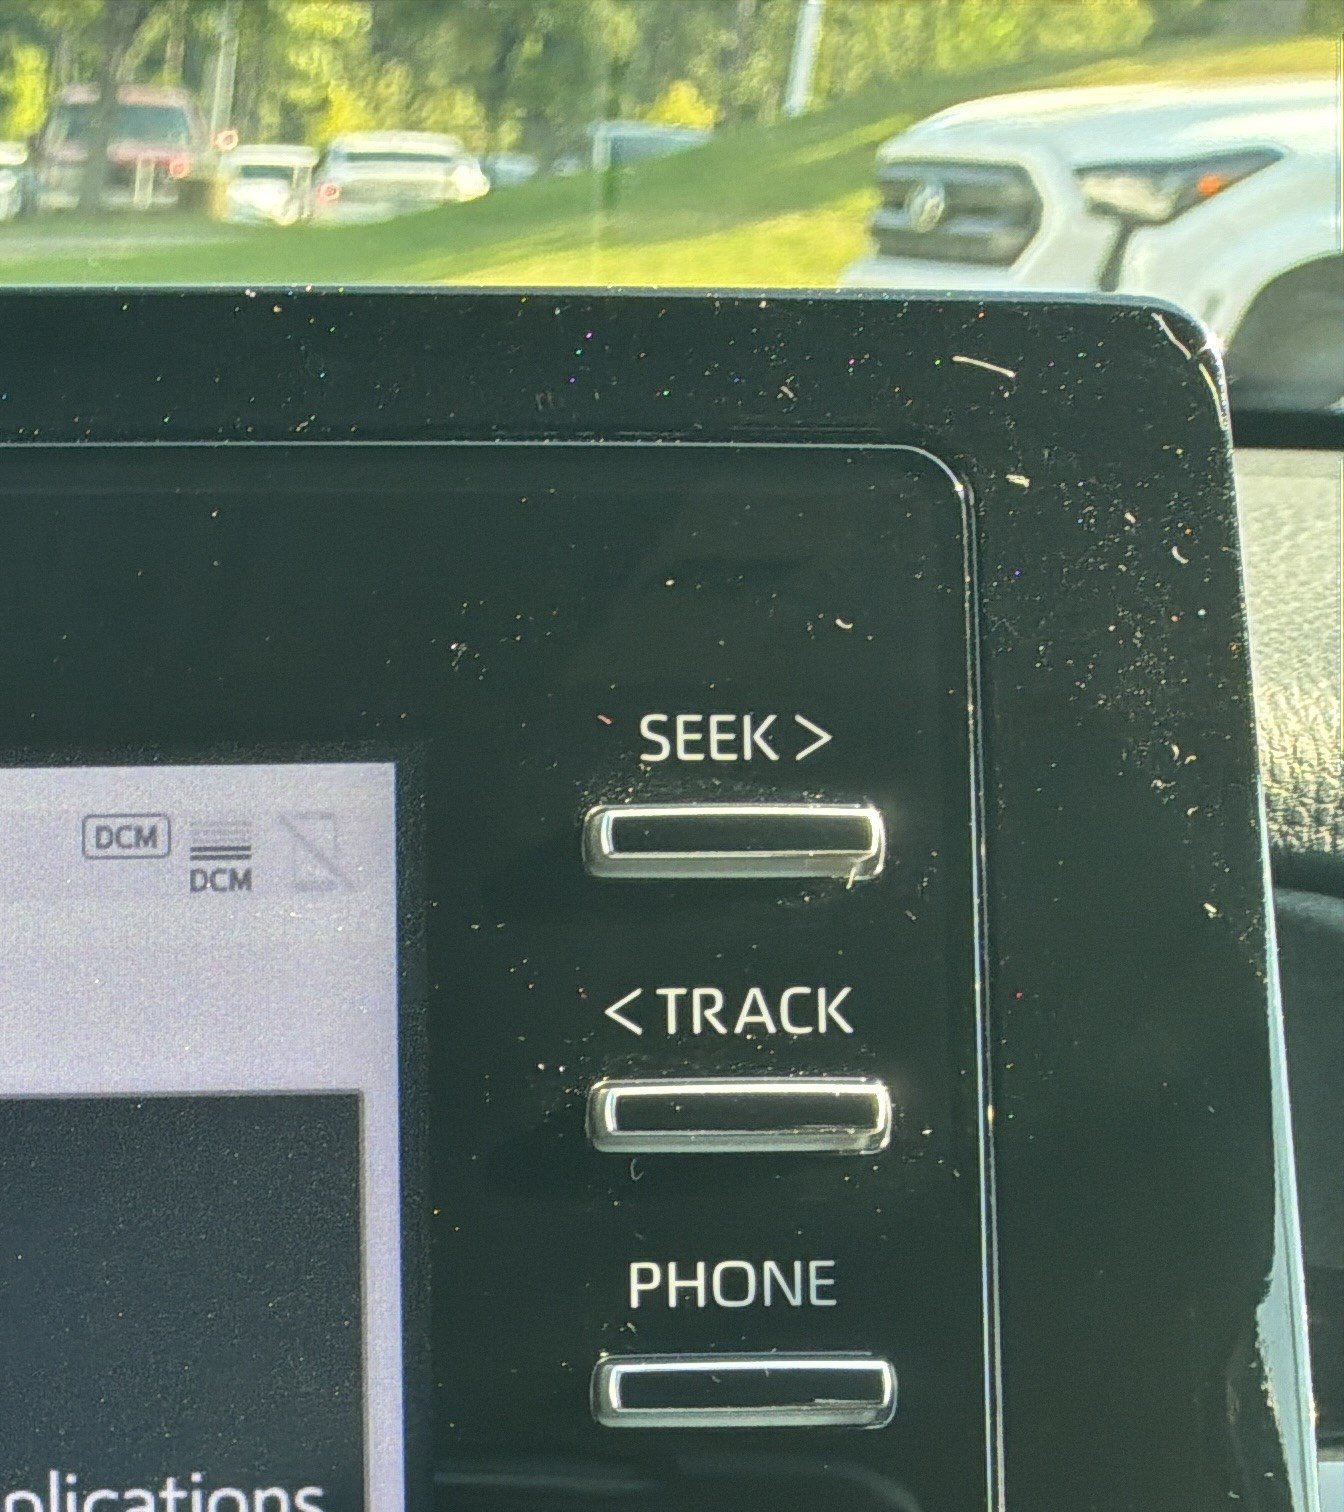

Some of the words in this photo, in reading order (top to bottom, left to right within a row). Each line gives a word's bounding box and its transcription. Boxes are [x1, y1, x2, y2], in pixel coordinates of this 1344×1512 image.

[93, 824, 159, 850] DCM
[190, 868, 253, 893] DCM
[629, 1260, 836, 1309] PHONE
